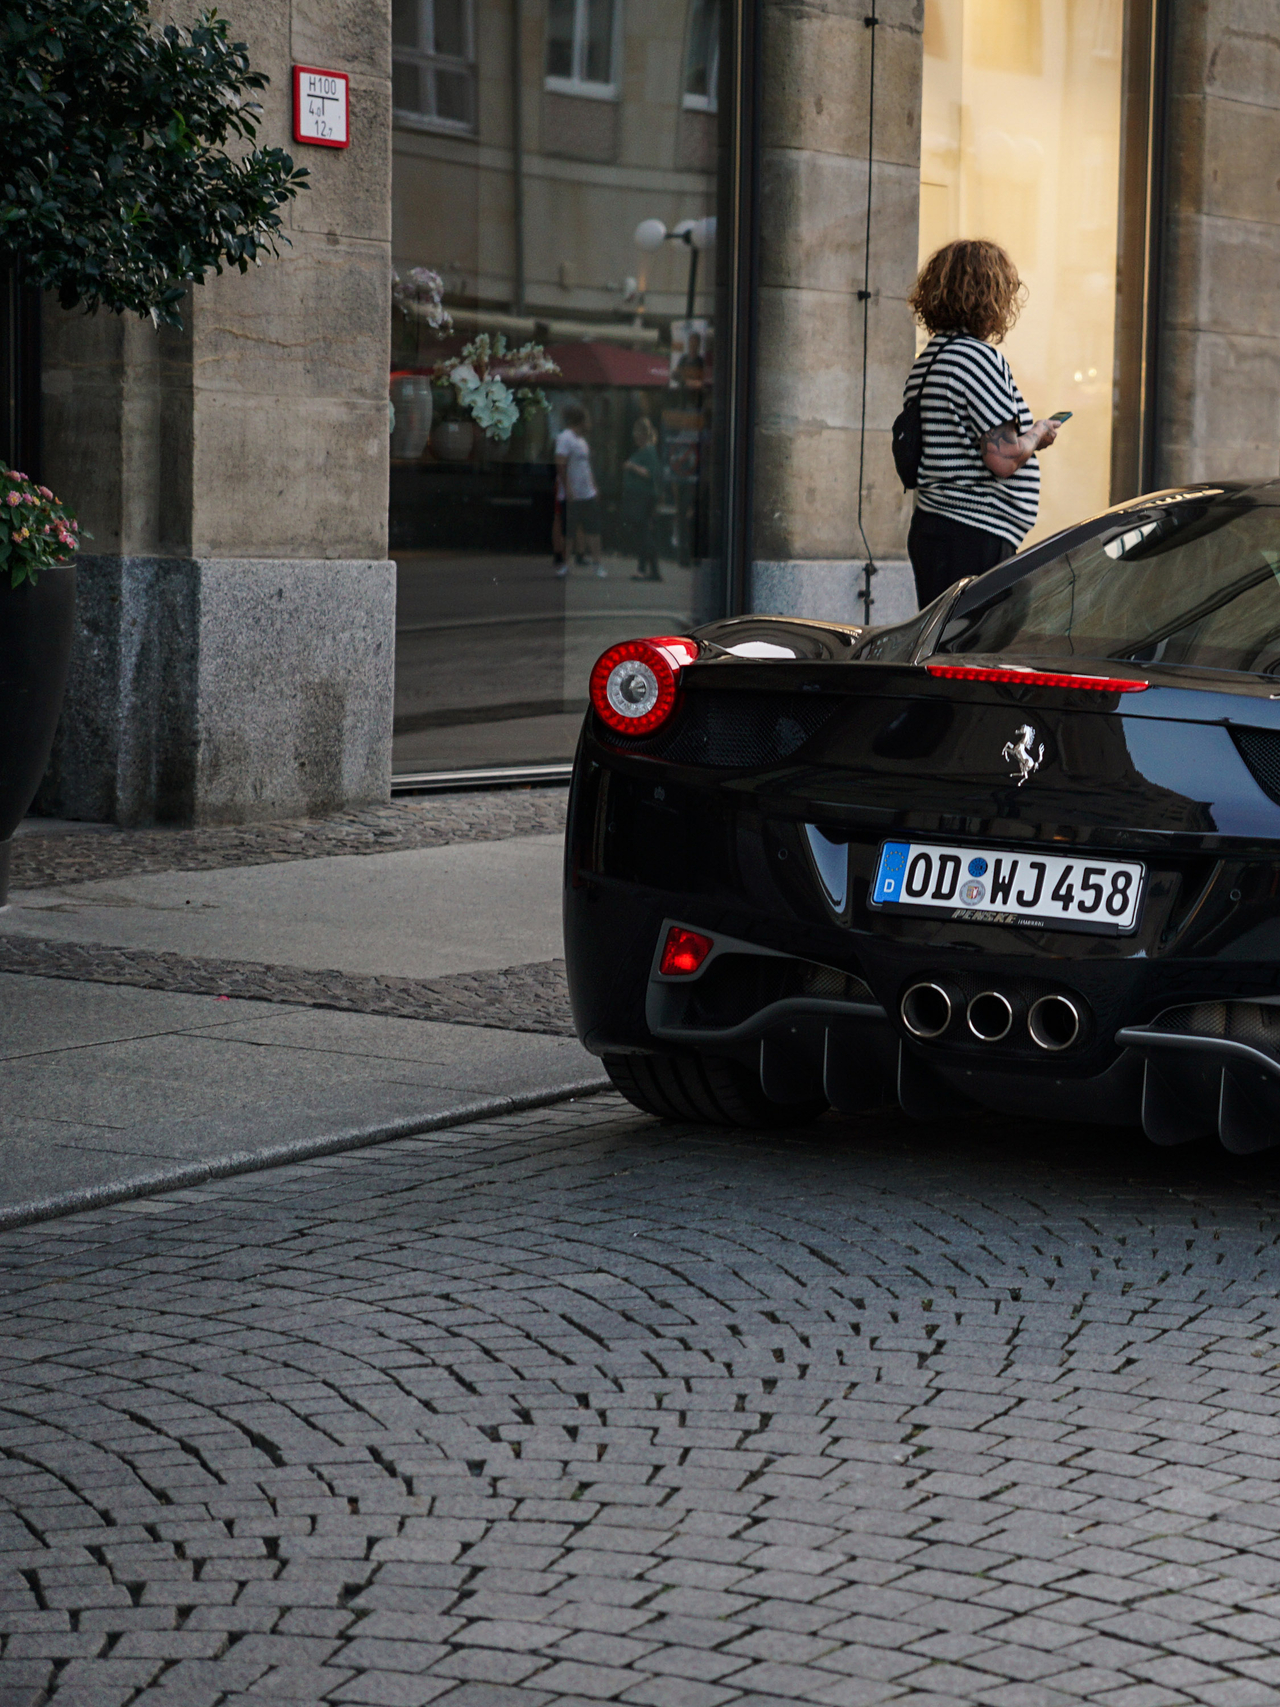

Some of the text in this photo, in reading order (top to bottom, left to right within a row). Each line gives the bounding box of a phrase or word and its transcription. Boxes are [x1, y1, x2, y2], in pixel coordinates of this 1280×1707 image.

[309, 76, 337, 95] H100
[905, 852, 962, 900] OD
[884, 879, 895, 893] D
[952, 909, 1017, 923] PENSKE
